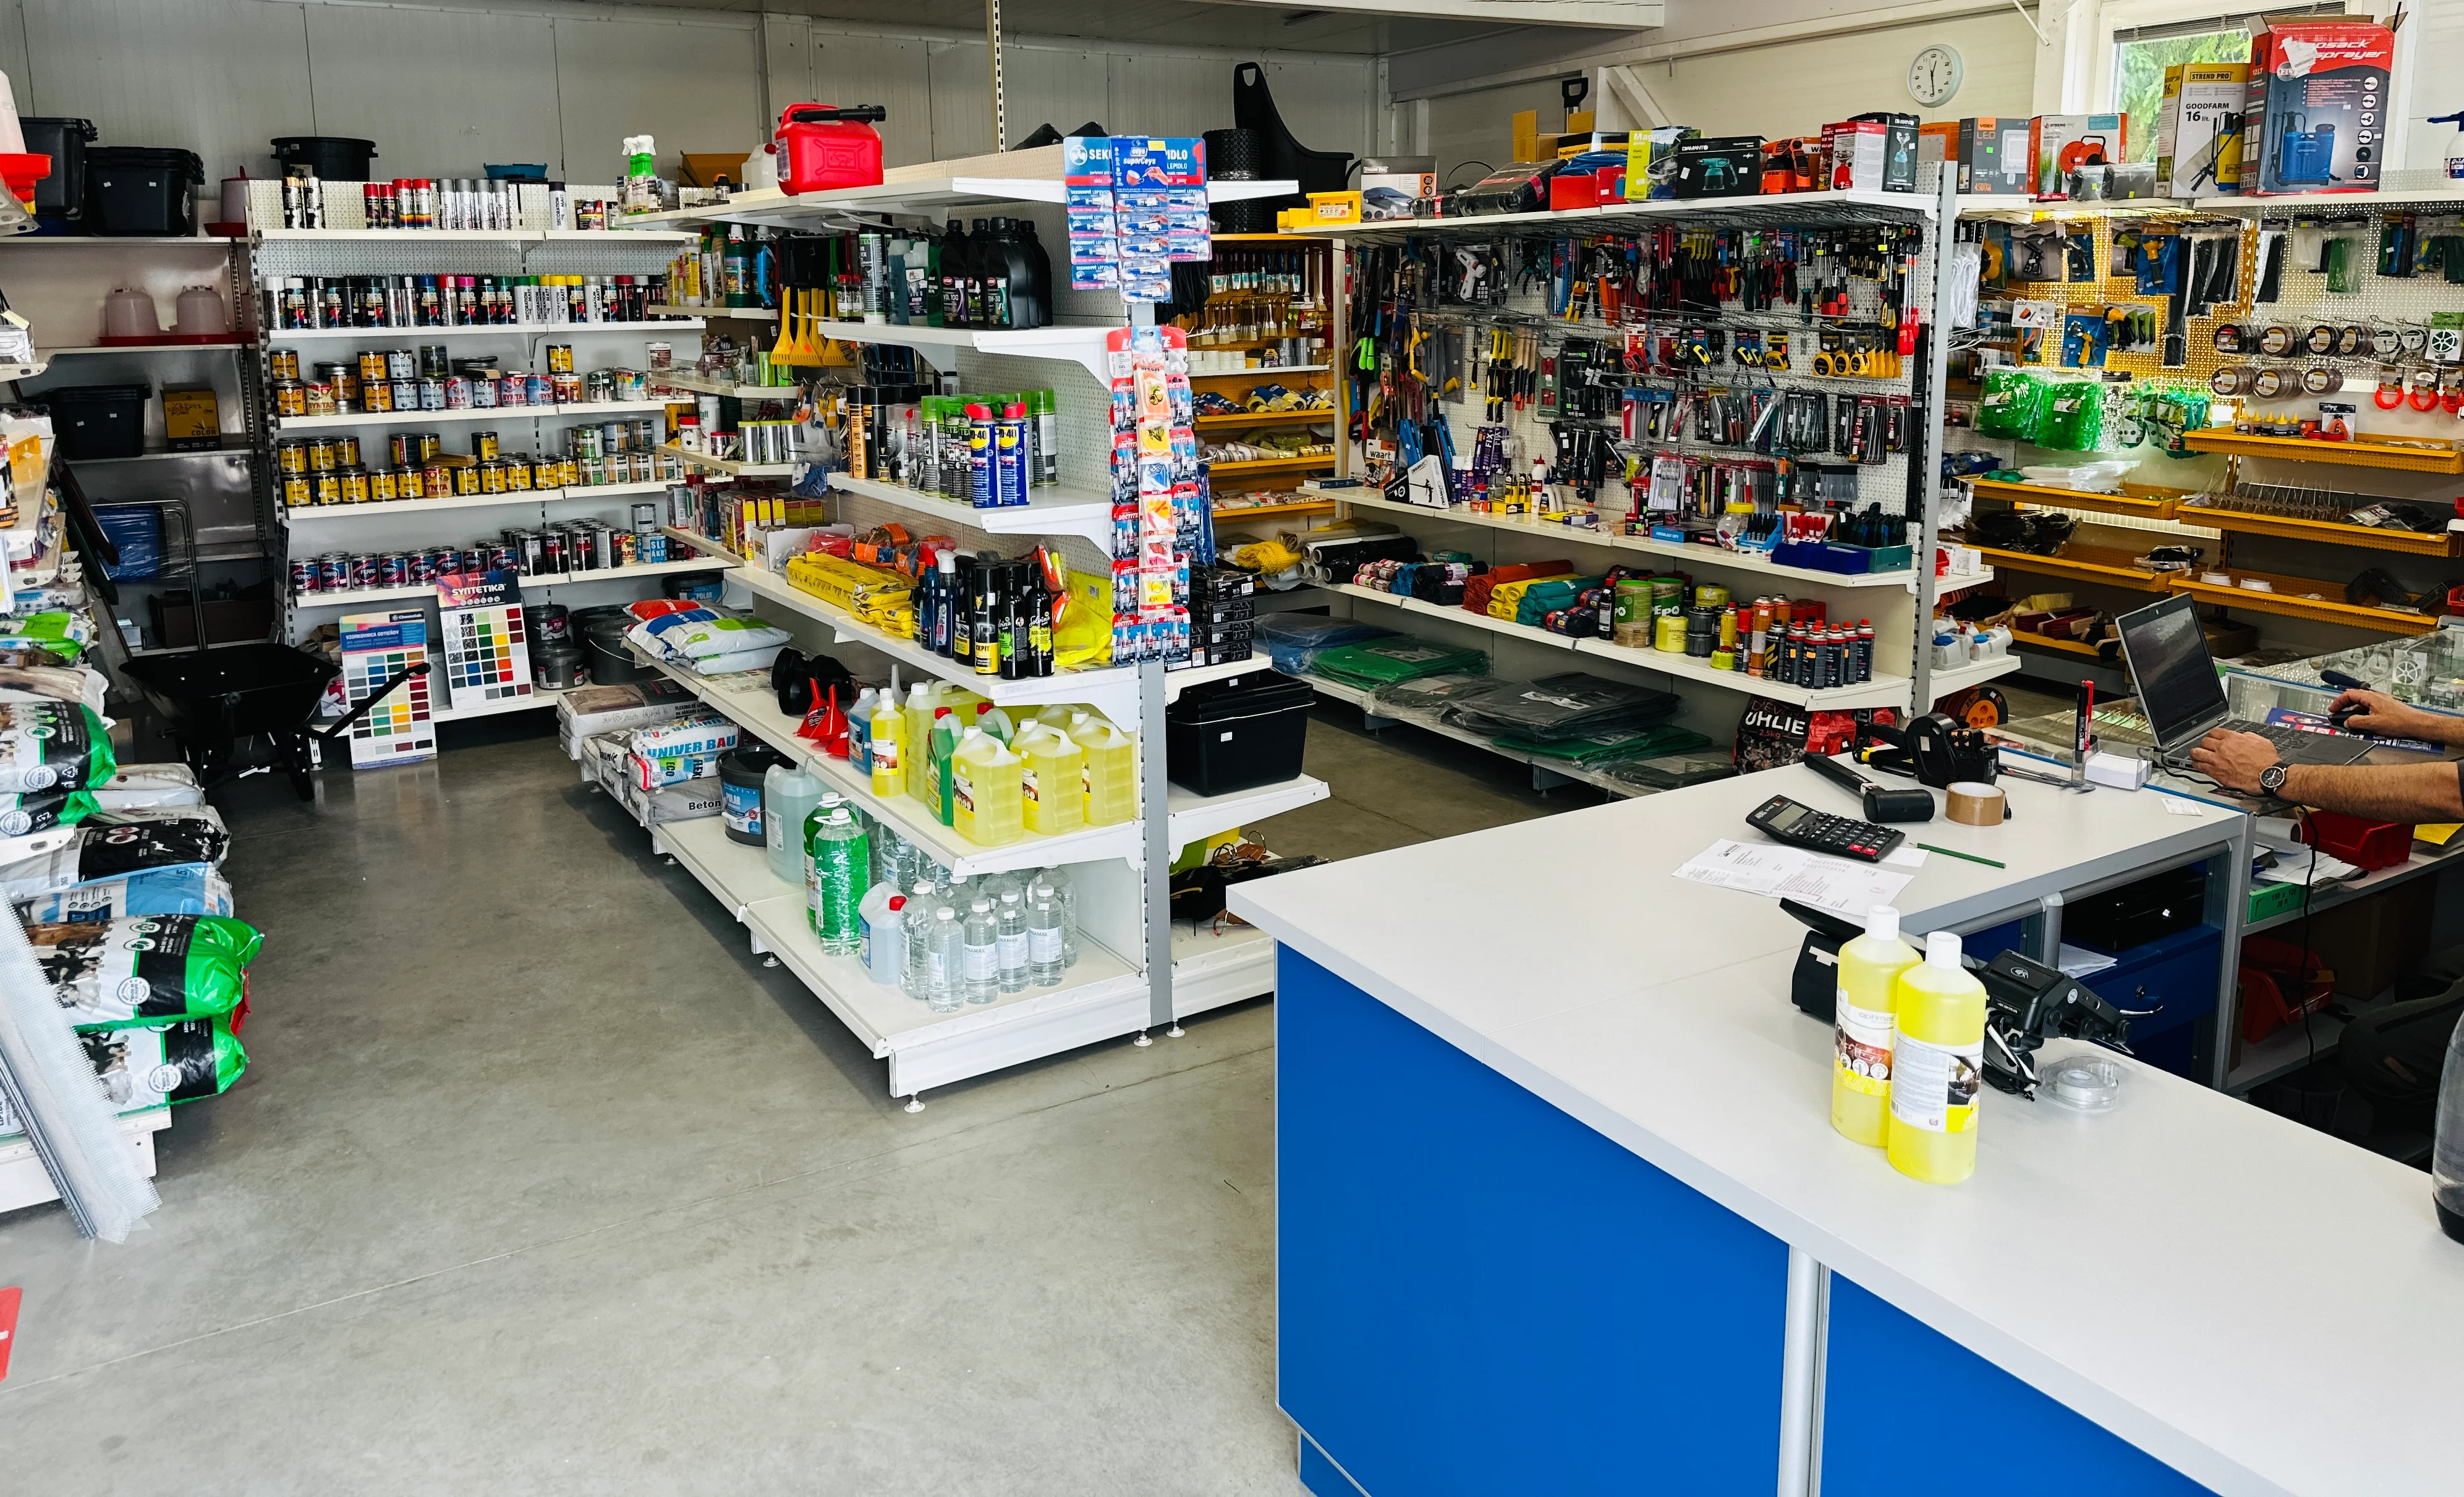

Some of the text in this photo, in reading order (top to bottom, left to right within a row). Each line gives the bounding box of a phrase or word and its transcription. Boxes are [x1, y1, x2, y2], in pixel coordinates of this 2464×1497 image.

[2186, 111, 2201, 121] 16
[1634, 132, 1675, 143] Magnum
[1977, 132, 1996, 140] LED
[1370, 451, 1391, 459] waart
[1745, 710, 1806, 736] UHLIE
[1759, 729, 1782, 739] 2,5kg
[647, 735, 736, 758] UNIVER BAU
[665, 761, 676, 777] ECO
[688, 799, 721, 811] Beton
[1858, 1012, 1894, 1022] optimal
